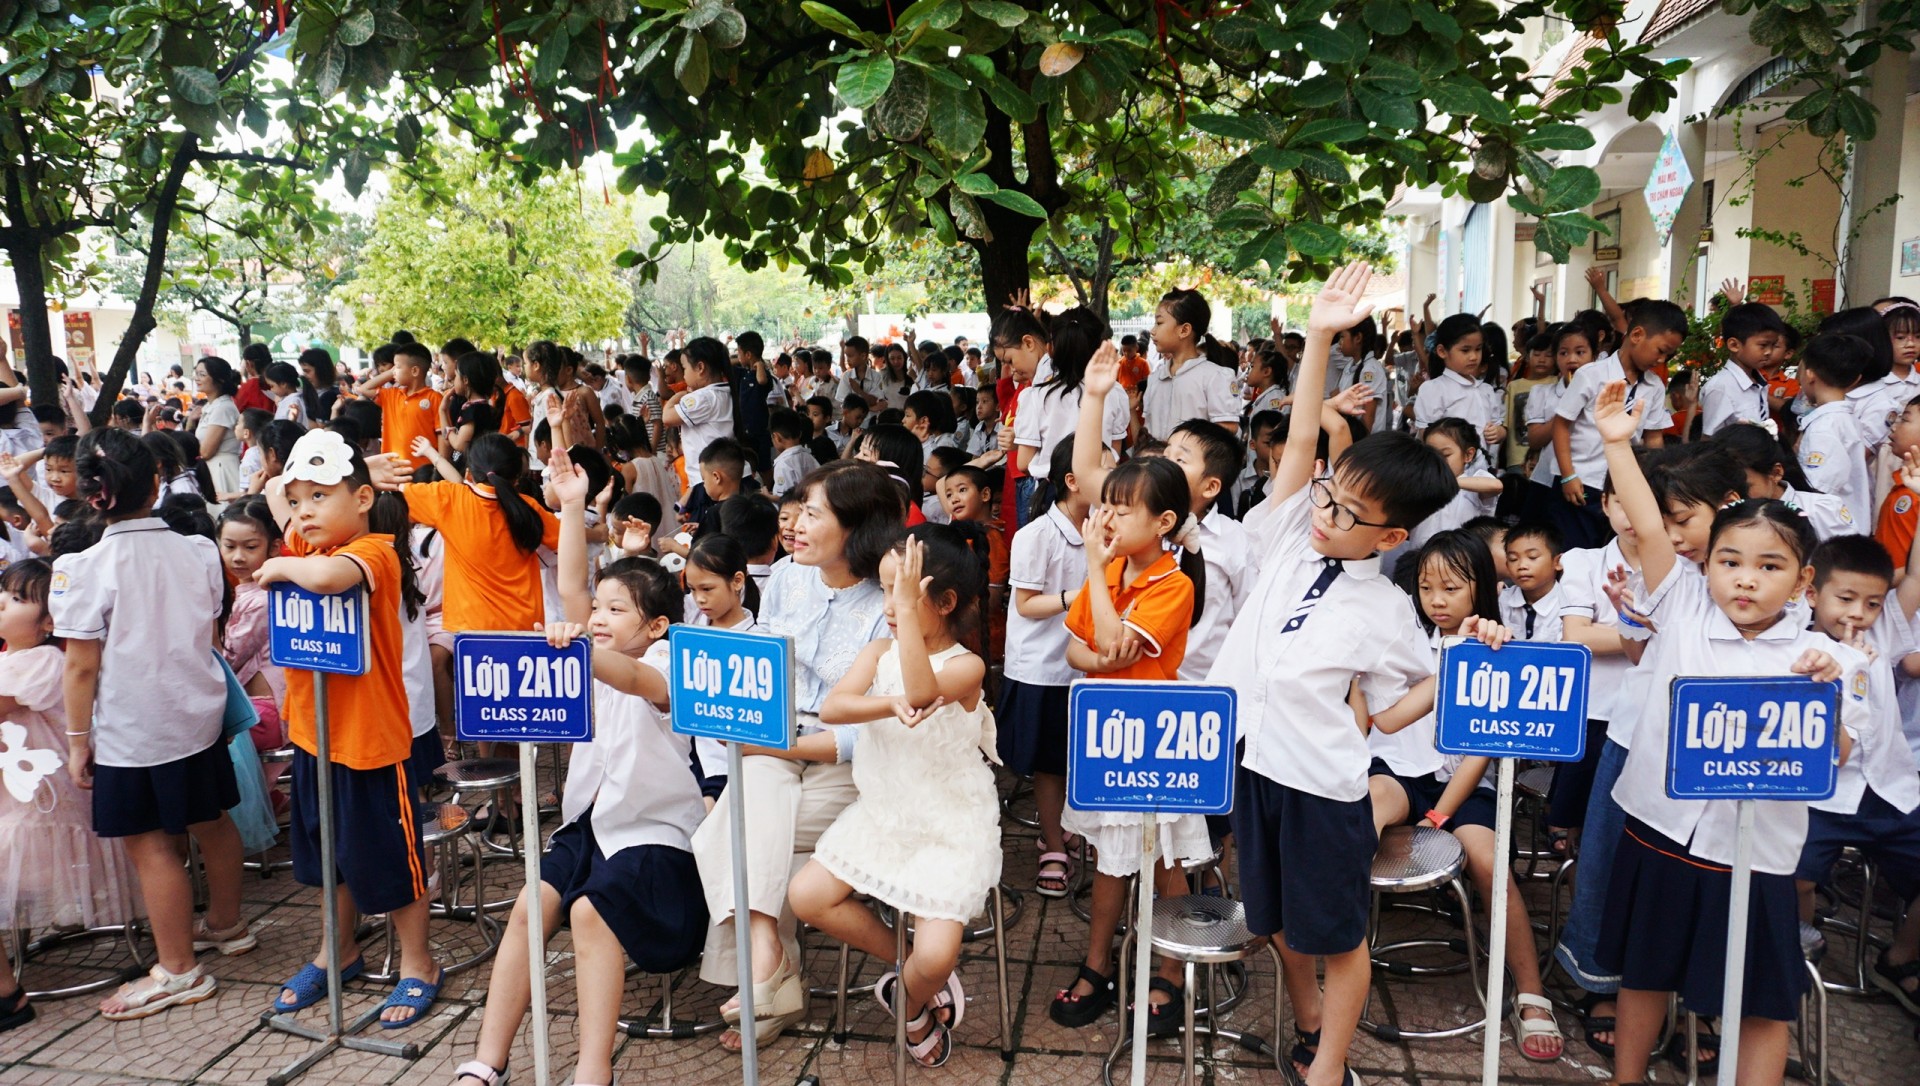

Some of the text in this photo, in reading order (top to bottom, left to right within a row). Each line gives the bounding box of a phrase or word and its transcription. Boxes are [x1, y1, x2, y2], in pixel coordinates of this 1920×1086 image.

[275, 590, 356, 635] Lớp 1A1
[290, 638, 342, 655] CLASS 1A1
[463, 654, 581, 701] Lớp 2A10
[682, 648, 773, 702] Lớp 2A9
[1456, 660, 1575, 713] Lớp 2A7
[481, 707, 567, 722] CLASS 2A10
[694, 702, 763, 725] CLASS 2A9
[1469, 718, 1555, 738] CLASS 2A7
[1686, 700, 1827, 754] Lớp 2A6
[1086, 708, 1222, 764] Lớp 2A8
[1104, 770, 1199, 789] CLASS 2A8
[1703, 760, 1803, 776] CLASS 2A6
